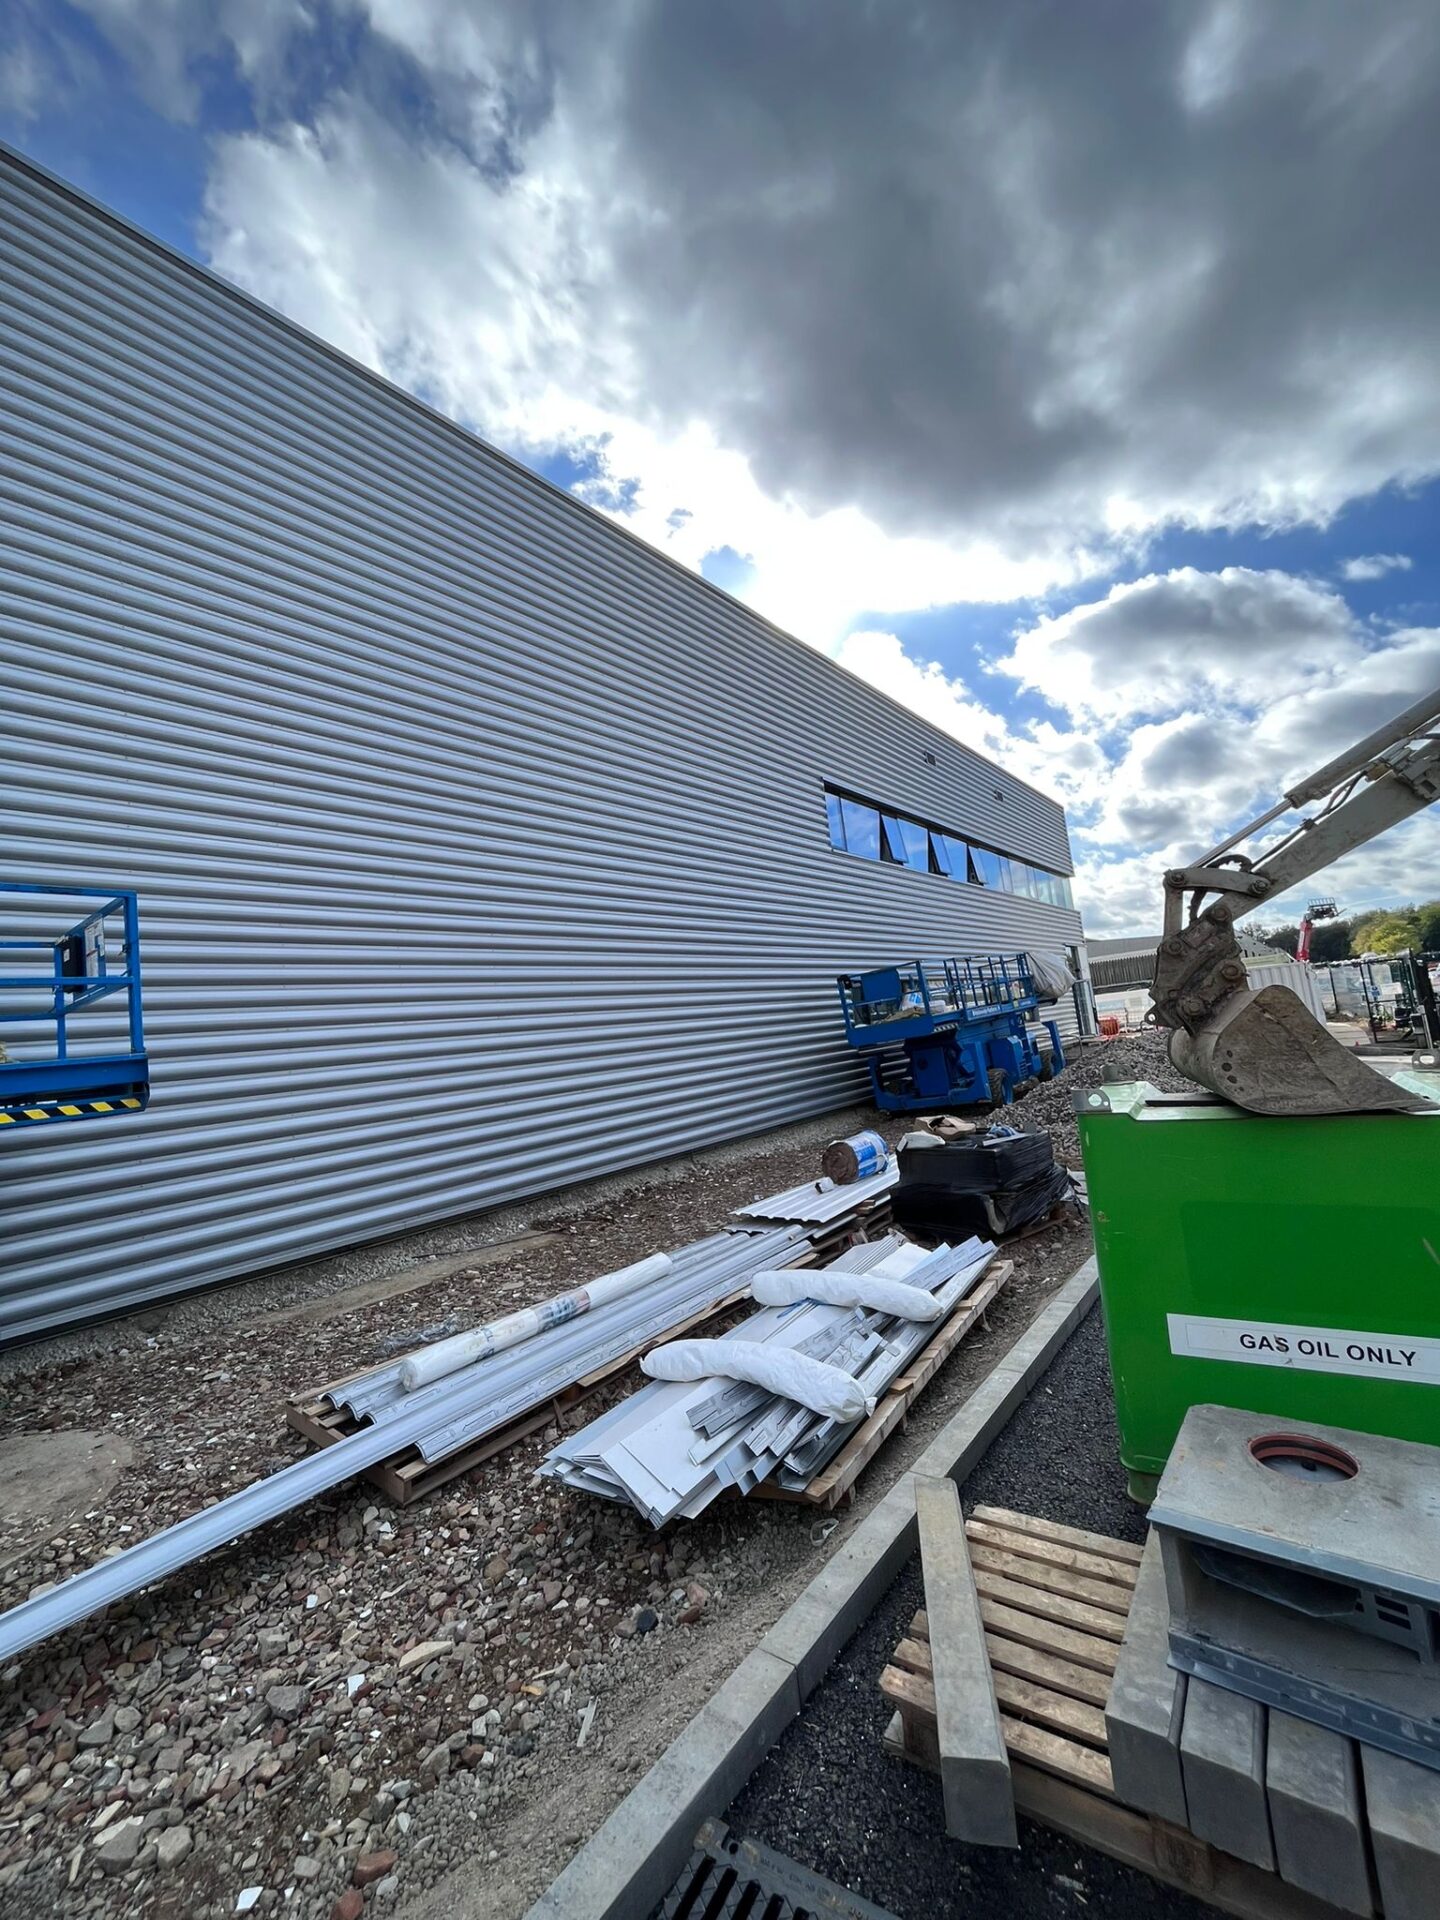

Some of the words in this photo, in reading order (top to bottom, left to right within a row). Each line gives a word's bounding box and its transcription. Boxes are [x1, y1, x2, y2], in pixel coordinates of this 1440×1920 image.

[1239, 1333, 1290, 1353] GAS
[1297, 1339, 1340, 1359] OIL
[1346, 1344, 1416, 1366] ONLY
